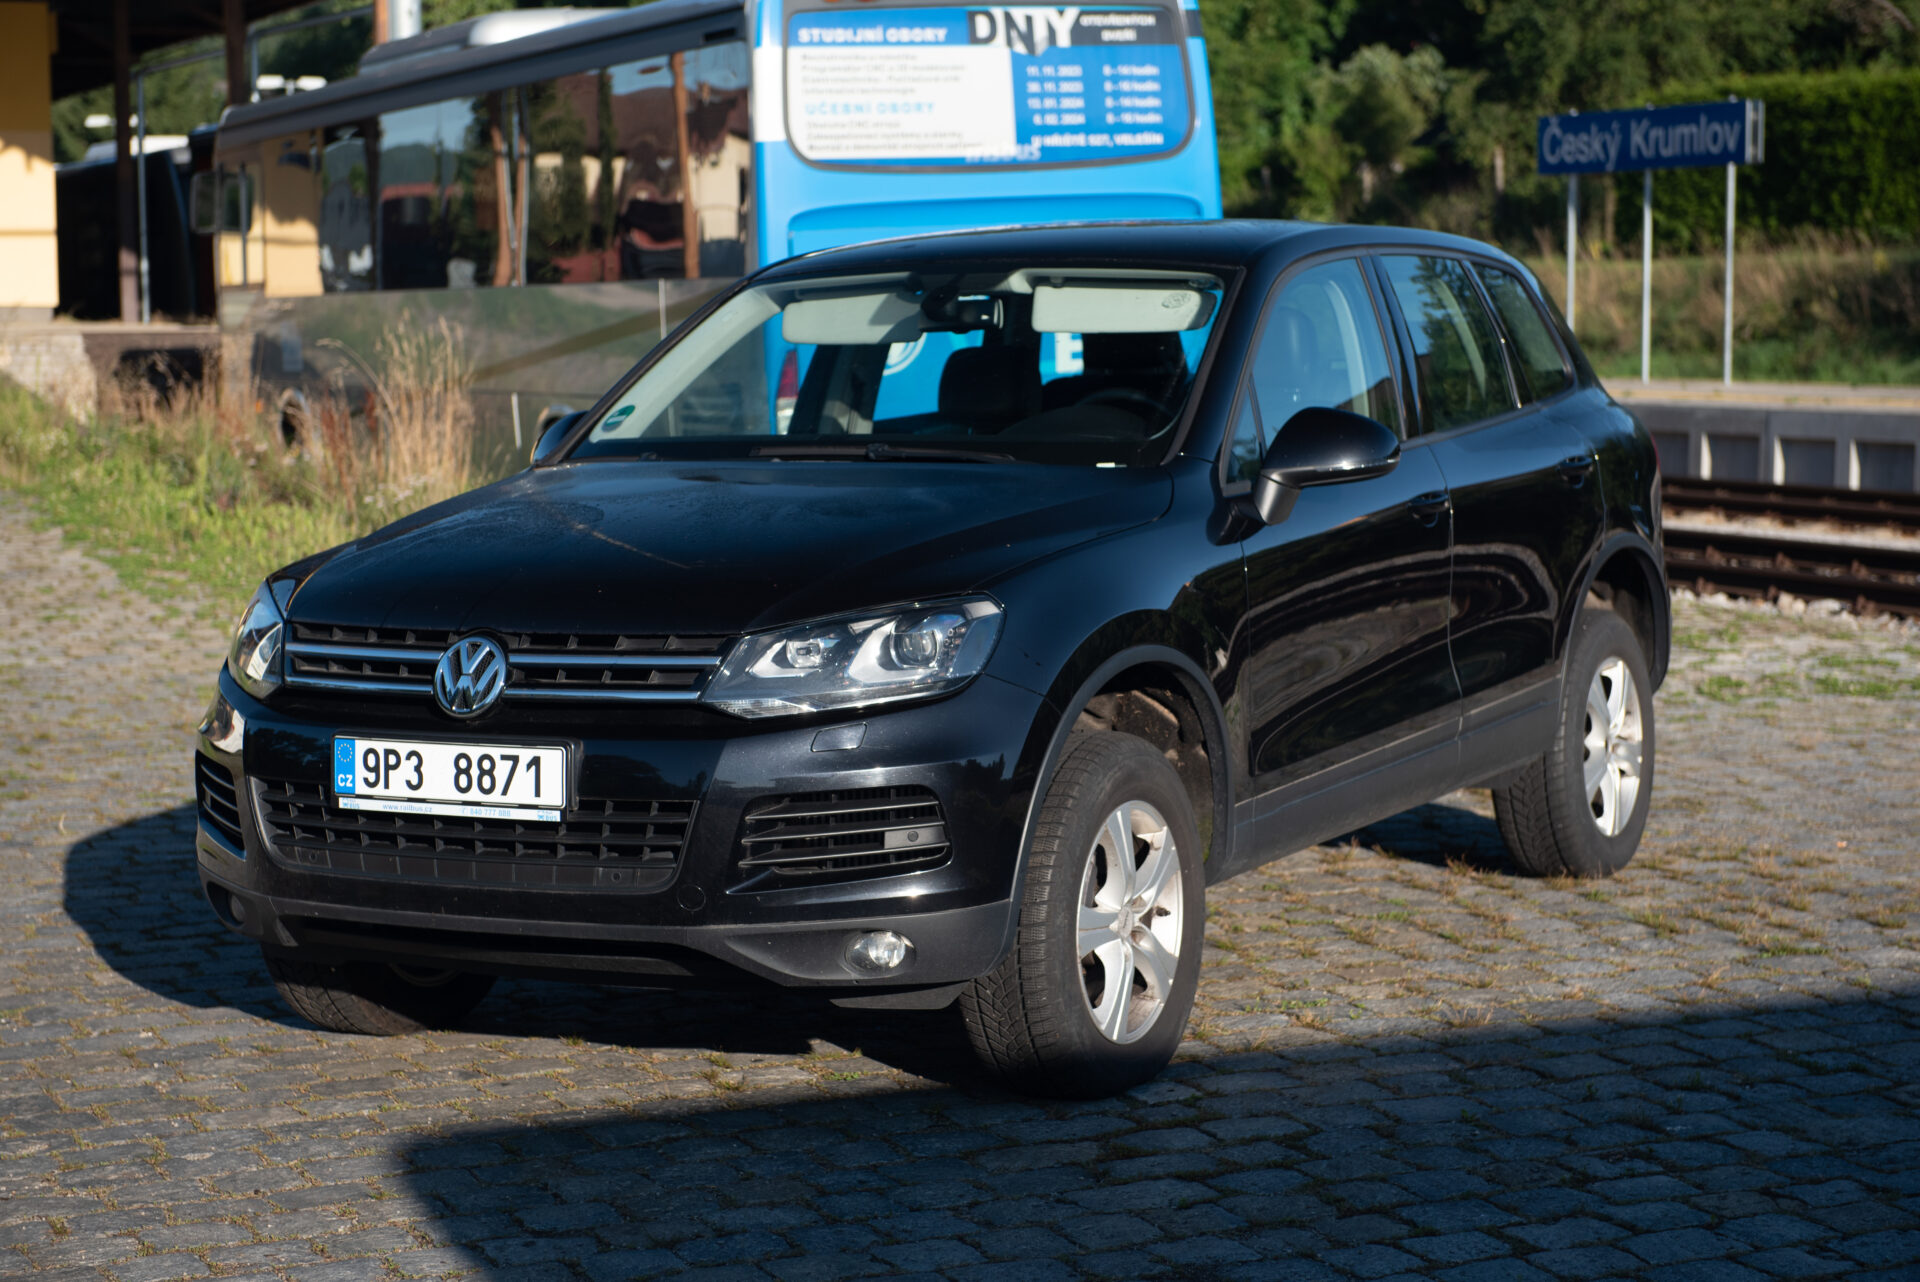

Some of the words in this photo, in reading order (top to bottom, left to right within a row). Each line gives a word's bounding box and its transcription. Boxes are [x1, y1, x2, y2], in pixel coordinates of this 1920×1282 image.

[798, 25, 884, 43] STUDIJNÍ
[886, 27, 948, 43] OBORY
[968, 8, 1080, 56] DNY
[805, 101, 871, 116] UČEBNÍ
[877, 102, 936, 114] OBORY
[1542, 117, 1621, 172] Český
[1630, 113, 1741, 160] Krumlov
[337, 774, 353, 787] CZ
[362, 748, 424, 791] 9P3
[453, 753, 541, 798] 8871
